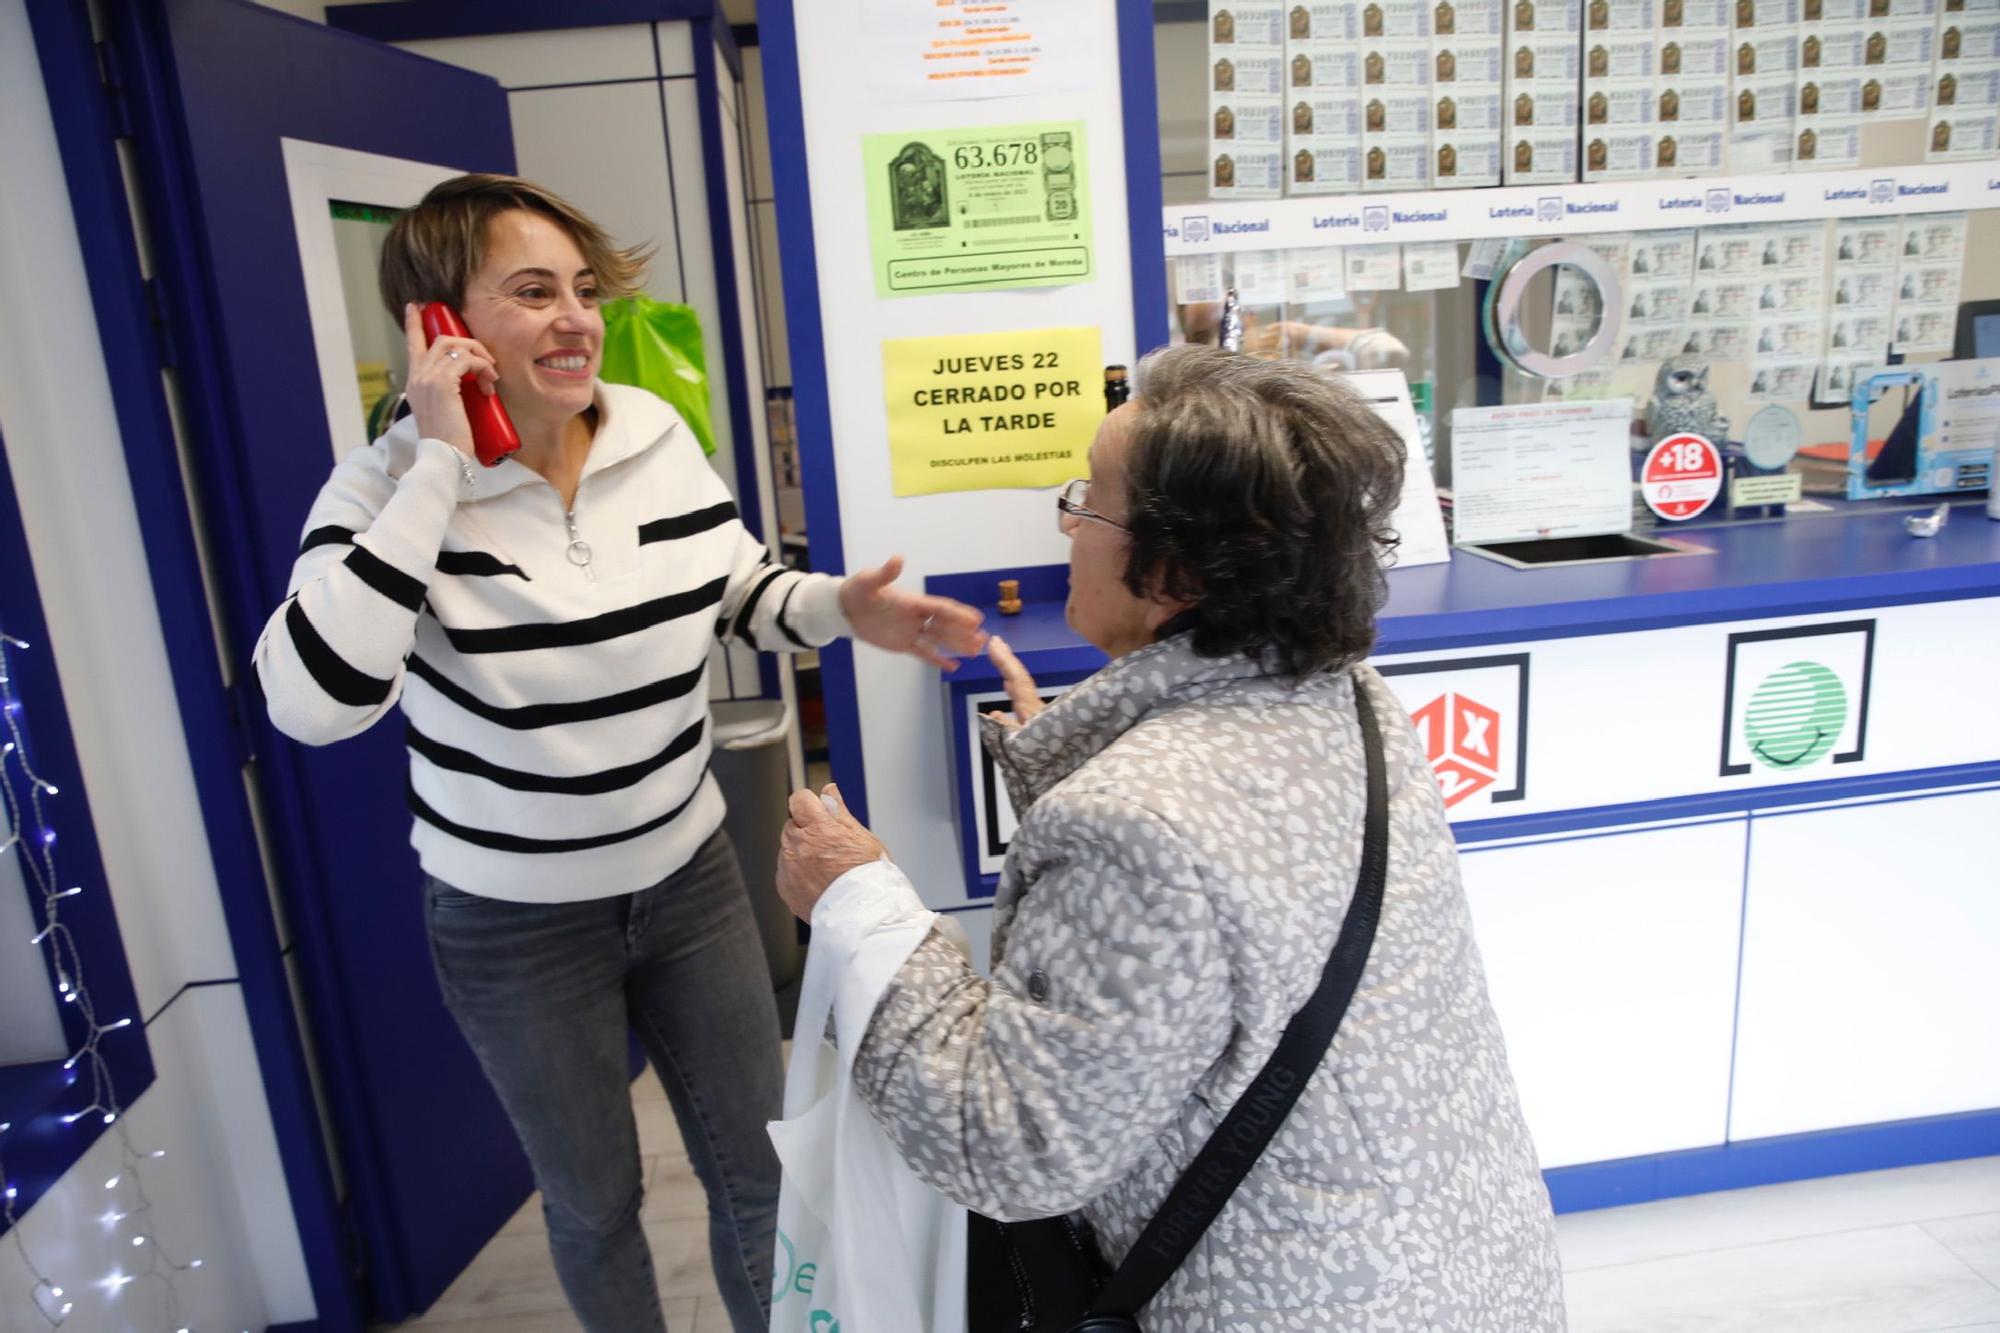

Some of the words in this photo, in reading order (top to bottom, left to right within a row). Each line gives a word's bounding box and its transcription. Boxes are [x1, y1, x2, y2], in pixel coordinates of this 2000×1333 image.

[954, 142, 1038, 169] 63.678
[1897, 180, 1949, 195] Nacional
[1566, 200, 1619, 213] Nacional
[1734, 191, 1786, 205] Nacional
[1213, 218, 1270, 234] Nacional
[1392, 209, 1447, 223] Nacional
[894, 268, 927, 279] Centro
[930, 267, 942, 276] de
[944, 264, 988, 275] Personas
[992, 261, 1031, 272] Mayores
[1034, 259, 1046, 268] de
[932, 354, 1025, 375] JUEVES
[1032, 352, 1059, 369] 22
[914, 384, 1026, 407] CERRADO
[1034, 381, 1081, 399] POR
[943, 417, 972, 435] LA
[980, 412, 1056, 432] TARDE
[930, 456, 989, 468] DISCULPEN
[992, 455, 1012, 464] LAS
[1014, 450, 1072, 462] MOLESTIAS
[1659, 442, 1704, 471] +18
[1153, 1160, 1233, 1256] FOREVER
[1229, 1065, 1297, 1155] YOUNG
